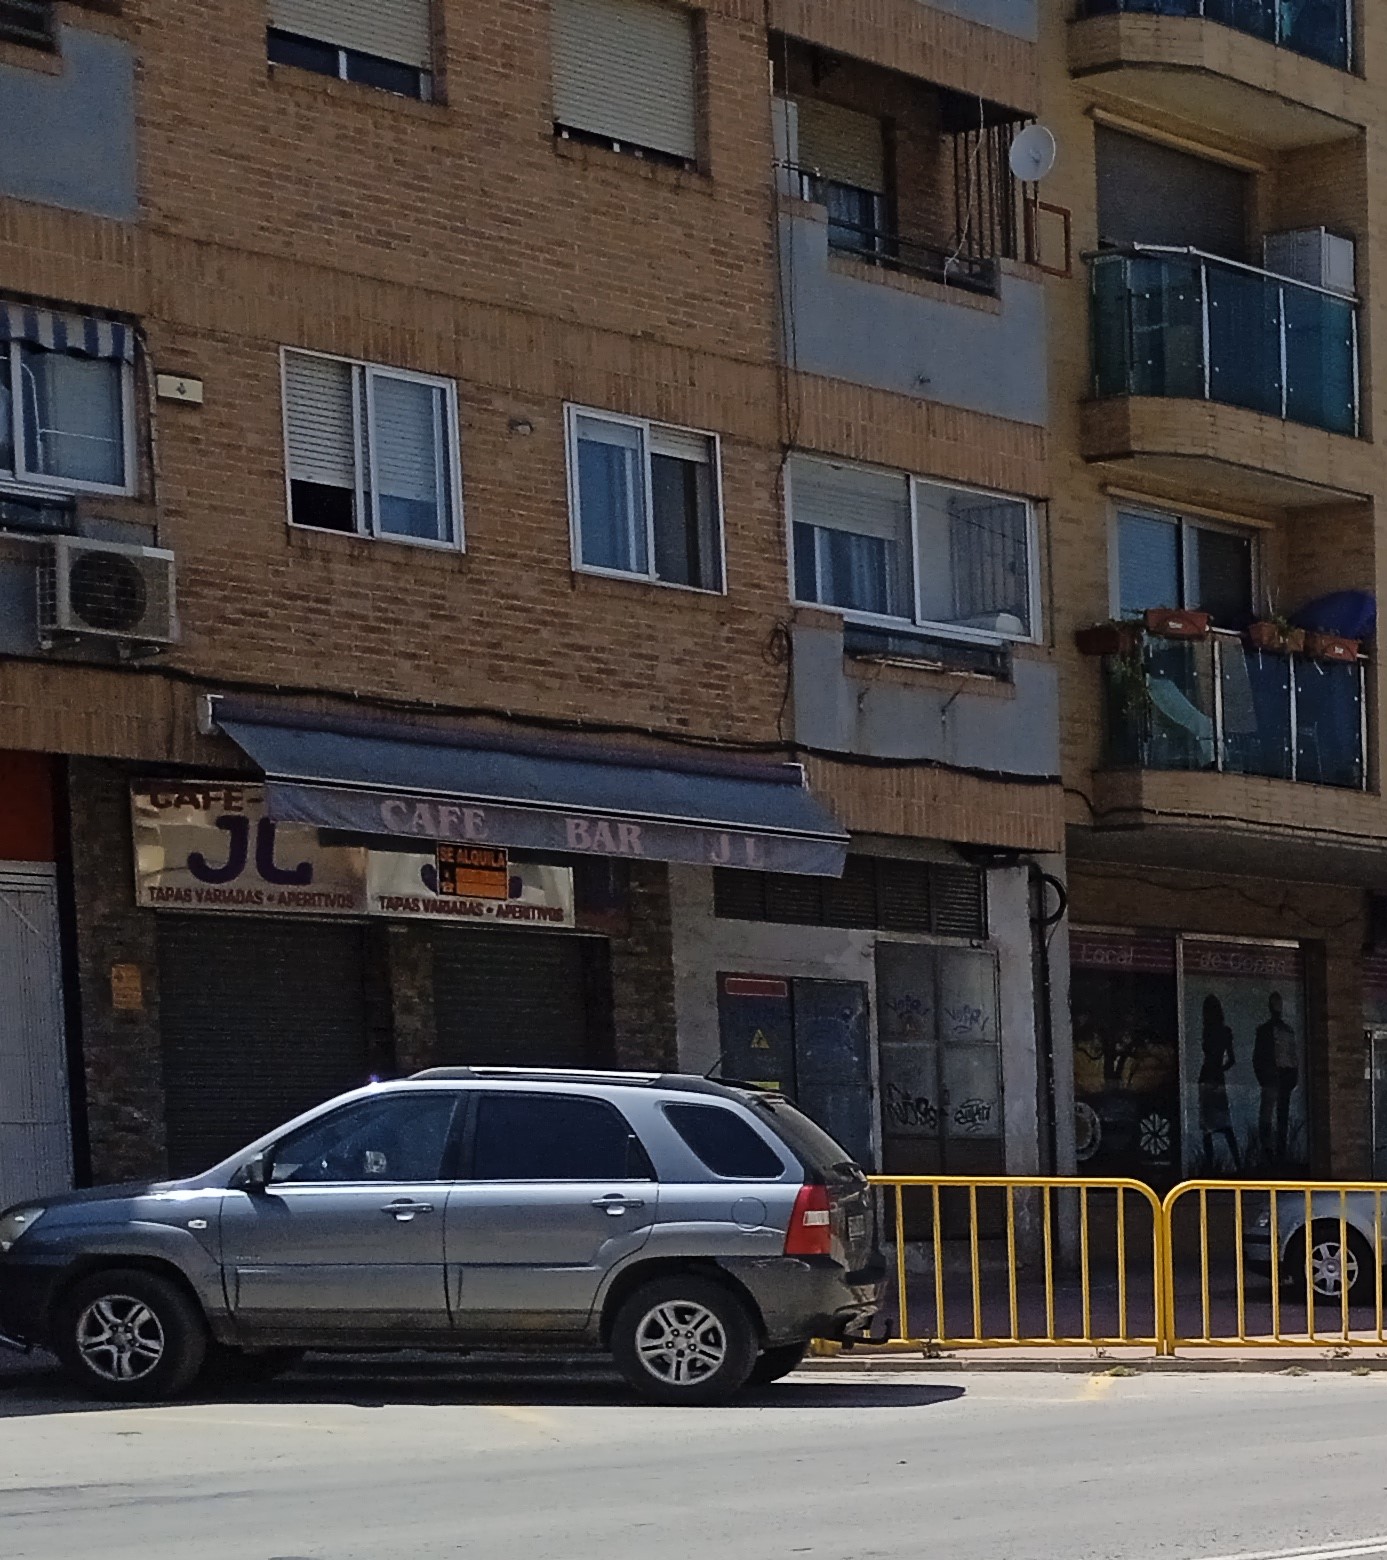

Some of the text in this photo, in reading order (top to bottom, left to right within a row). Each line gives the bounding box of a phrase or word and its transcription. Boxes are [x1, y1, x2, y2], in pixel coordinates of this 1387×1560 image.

[565, 817, 645, 855] BAR
[439, 846, 506, 867] SE ALQUILA
[148, 886, 356, 909] TAPAS VARIADAS APERITIVOS
[378, 895, 564, 922] TAPAS VARIADAS APERITIVOS
